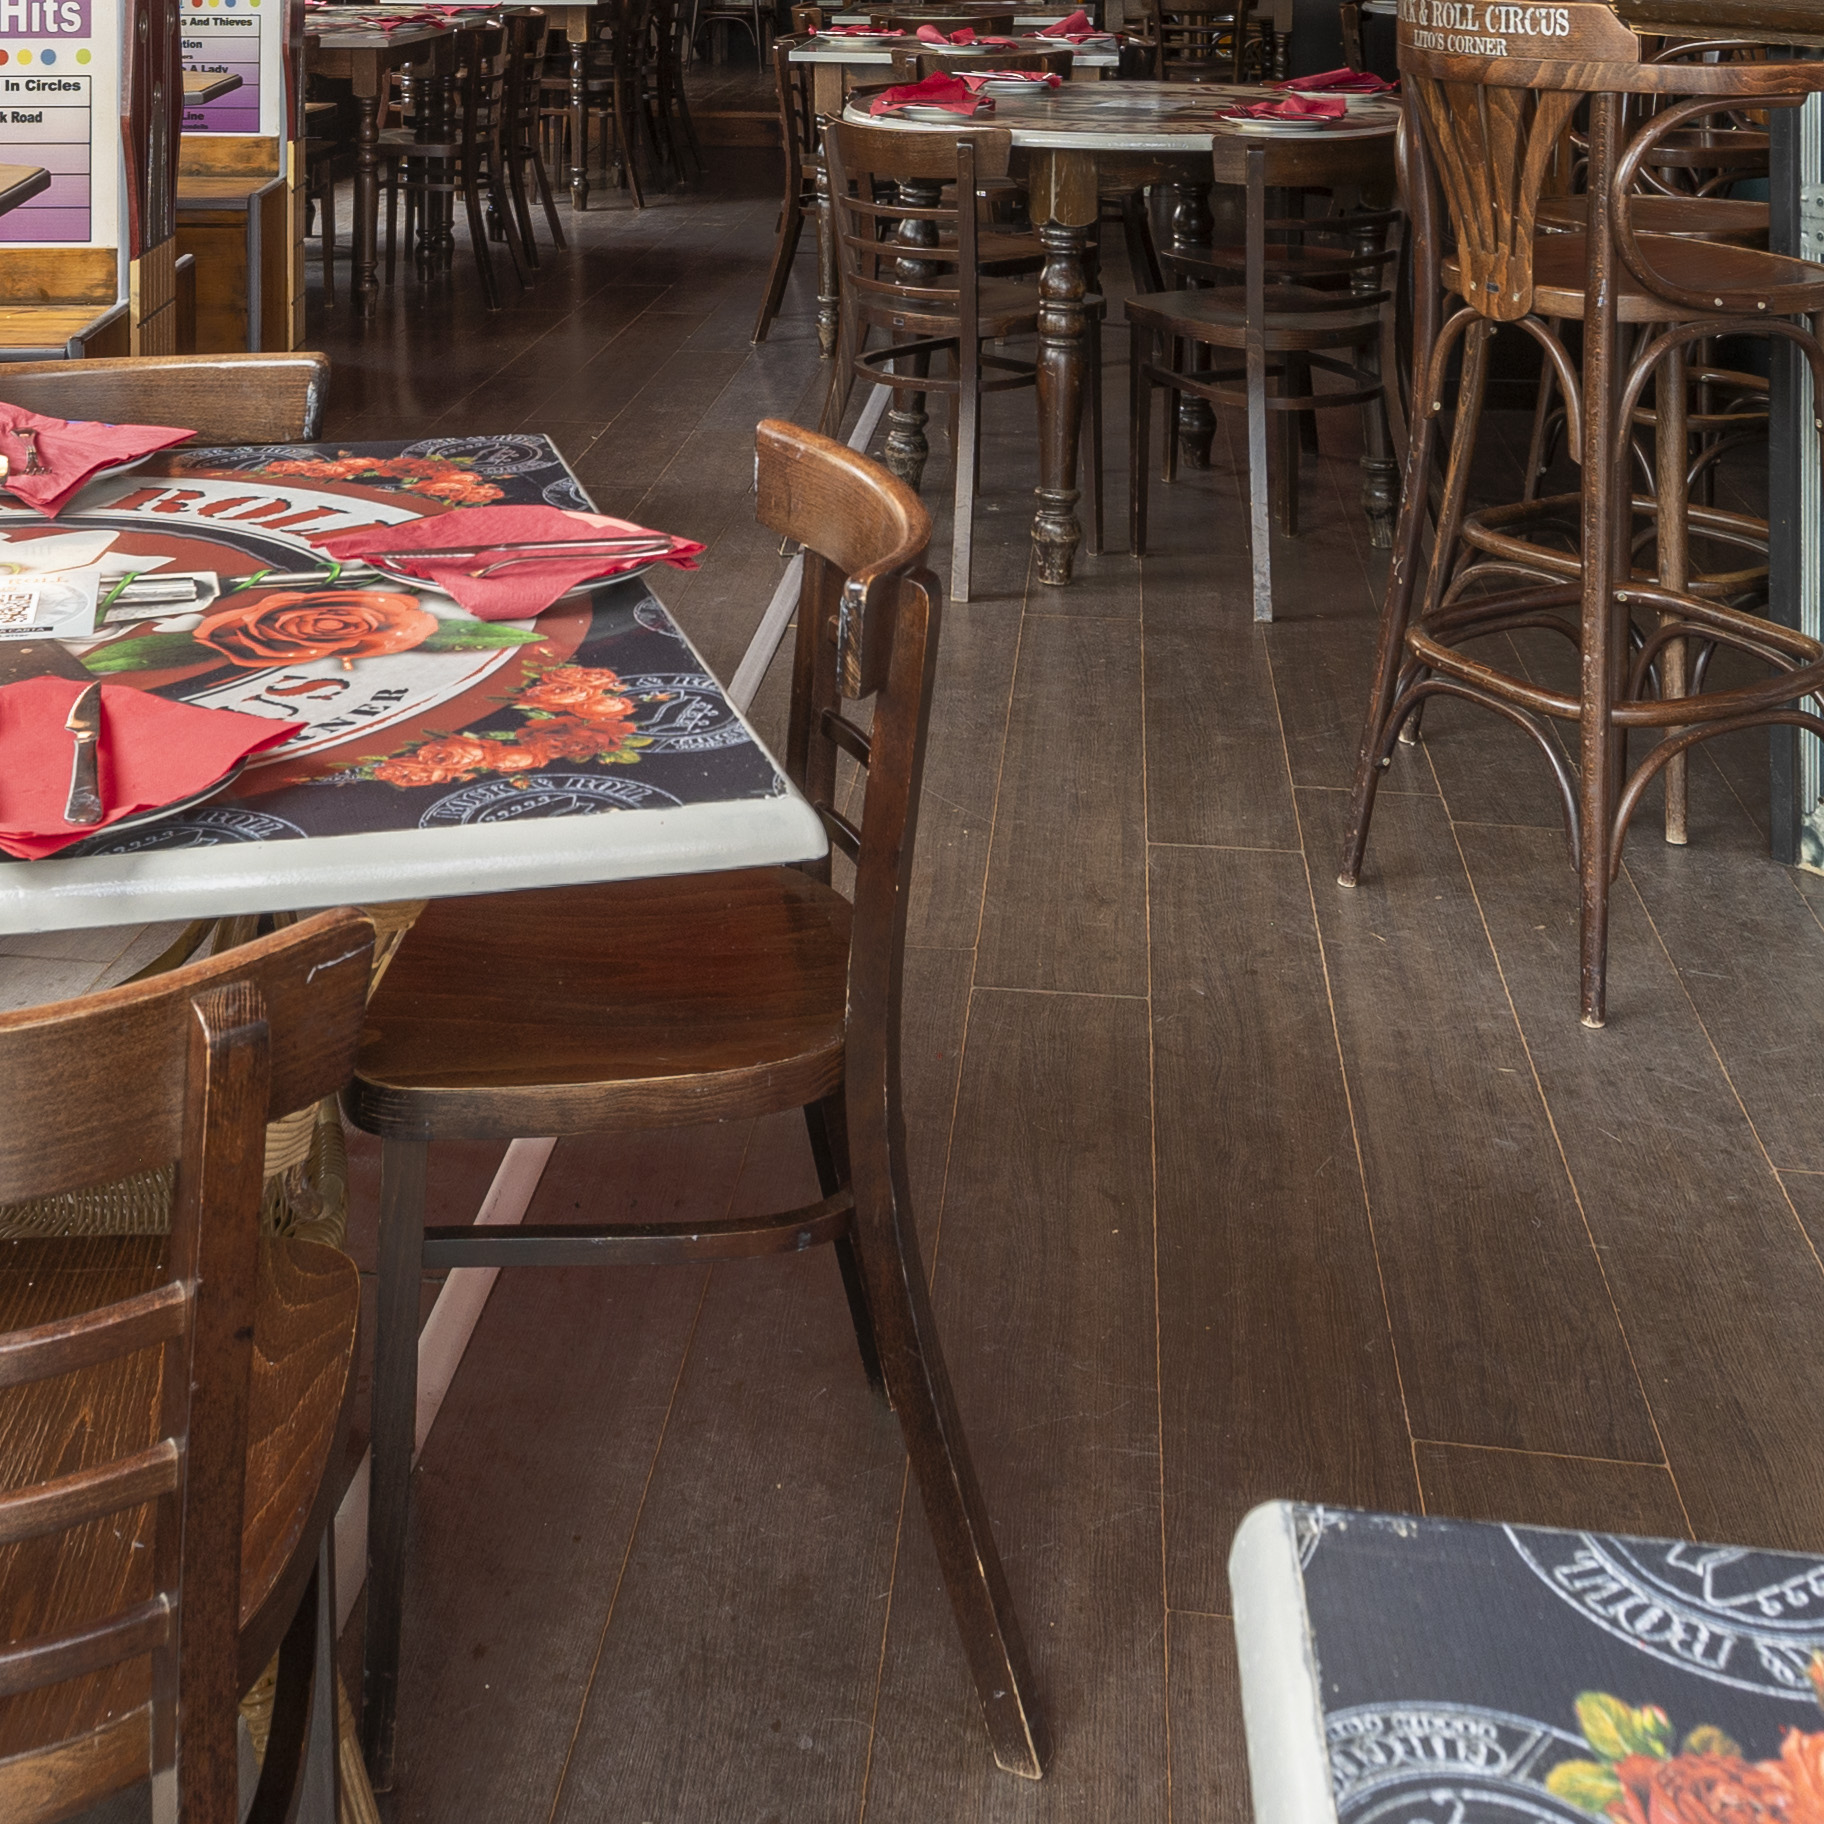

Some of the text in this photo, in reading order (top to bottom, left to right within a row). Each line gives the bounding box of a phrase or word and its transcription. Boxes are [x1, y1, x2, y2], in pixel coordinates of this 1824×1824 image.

[189, 17, 253, 27] And Thieves
[1431, 0, 1480, 32] ROLL
[1484, 5, 1570, 37] CIRCUS
[1447, 34, 1508, 57] CORNER
[5, 80, 20, 92] In
[25, 79, 82, 92] Circles
[11, 111, 43, 123] Road
